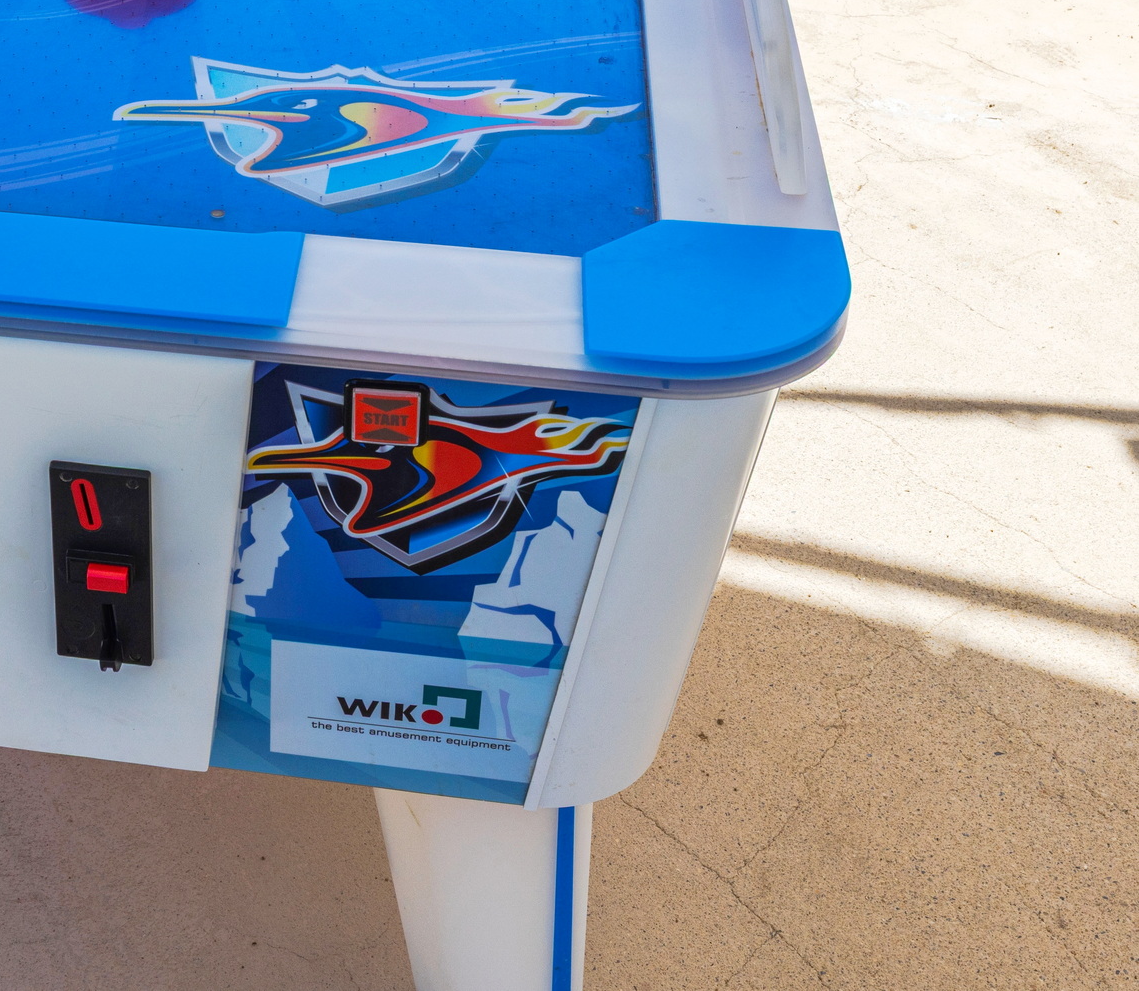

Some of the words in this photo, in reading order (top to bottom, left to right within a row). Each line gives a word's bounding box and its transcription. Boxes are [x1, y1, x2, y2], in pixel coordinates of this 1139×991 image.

[363, 412, 410, 427] START
[311, 721, 333, 731] the
[336, 723, 365, 735] best
[369, 728, 442, 744] amusement
[446, 737, 512, 752] equipment
